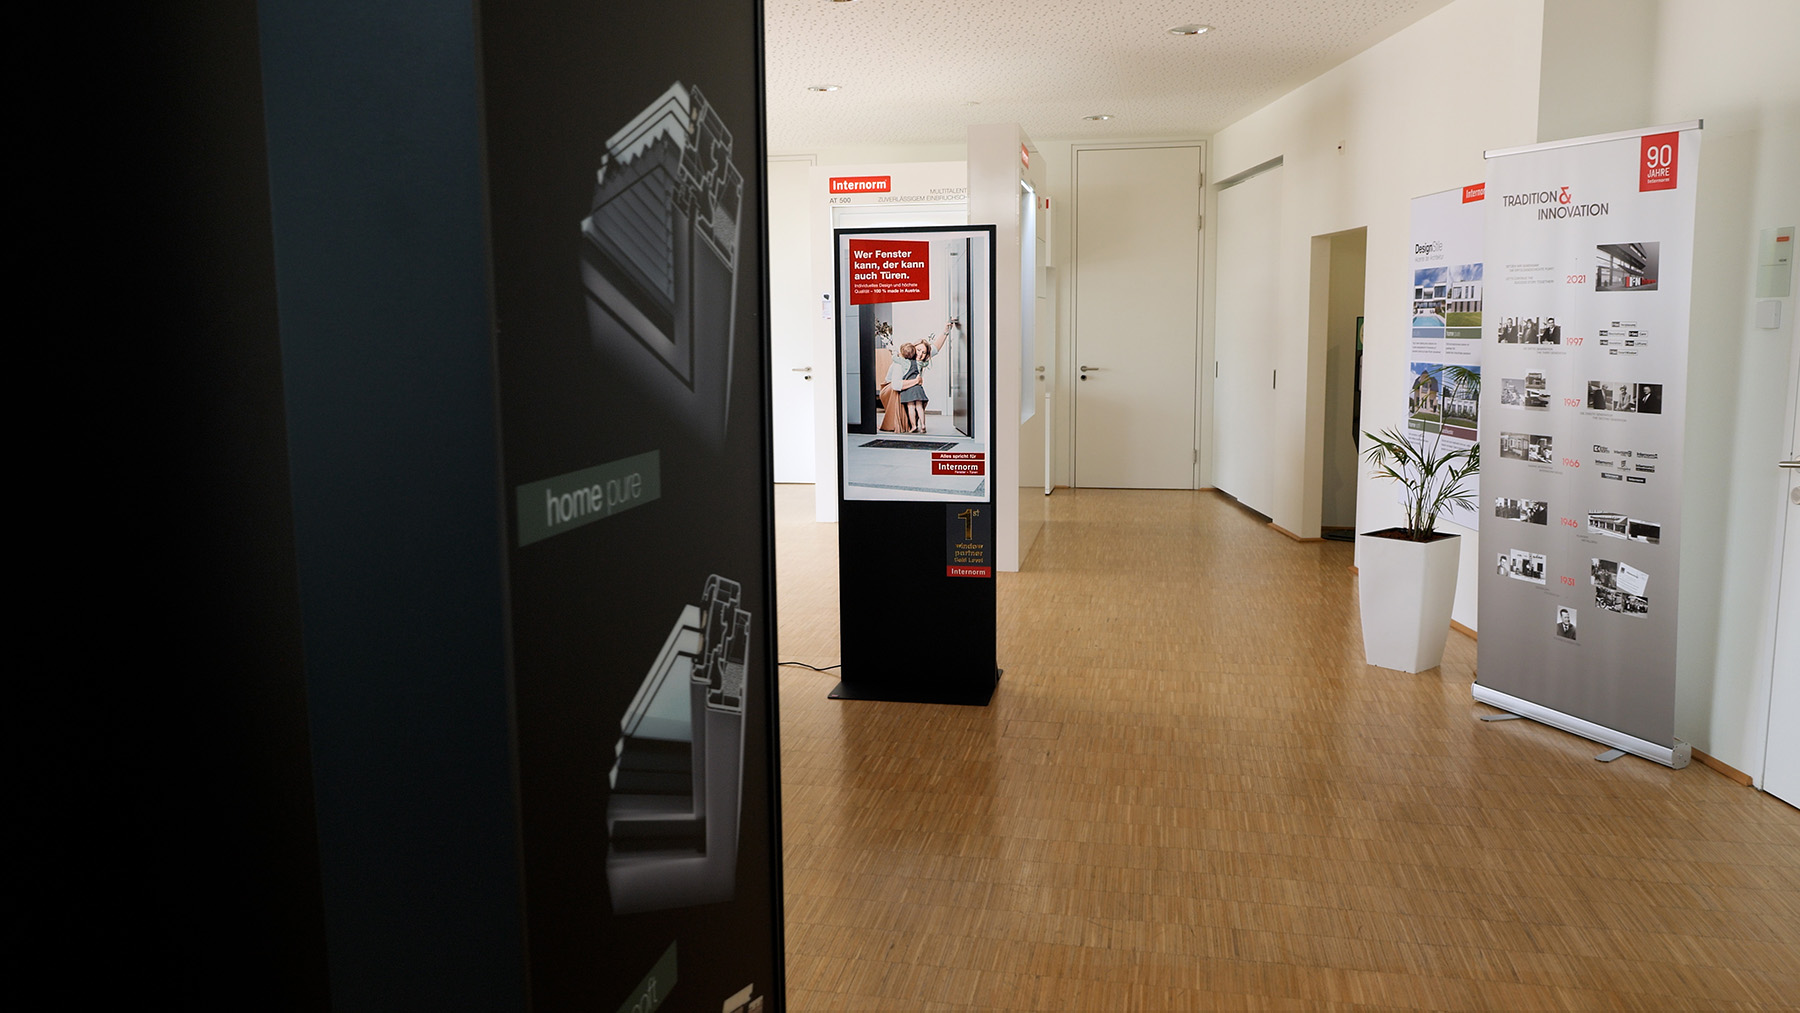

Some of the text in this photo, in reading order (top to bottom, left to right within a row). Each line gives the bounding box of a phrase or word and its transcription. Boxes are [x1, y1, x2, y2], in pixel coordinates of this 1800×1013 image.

[1647, 144, 1672, 168] 90
[1648, 168, 1670, 178] JAHRE
[833, 180, 886, 190] Internorm
[1466, 188, 1484, 198] Interno
[1503, 186, 1572, 207] TRADITION &
[1538, 203, 1609, 220] INNOVATION
[875, 250, 912, 258] Fenster
[854, 262, 880, 270] kann,
[854, 271, 910, 280] auch Türen.
[1567, 275, 1586, 284] 2021
[1566, 337, 1584, 346] 1997
[1564, 398, 1581, 408] 1967
[1562, 458, 1580, 468] 1966
[546, 472, 641, 526] home pure
[1560, 517, 1578, 528] 1946
[1560, 576, 1575, 586] 1931
